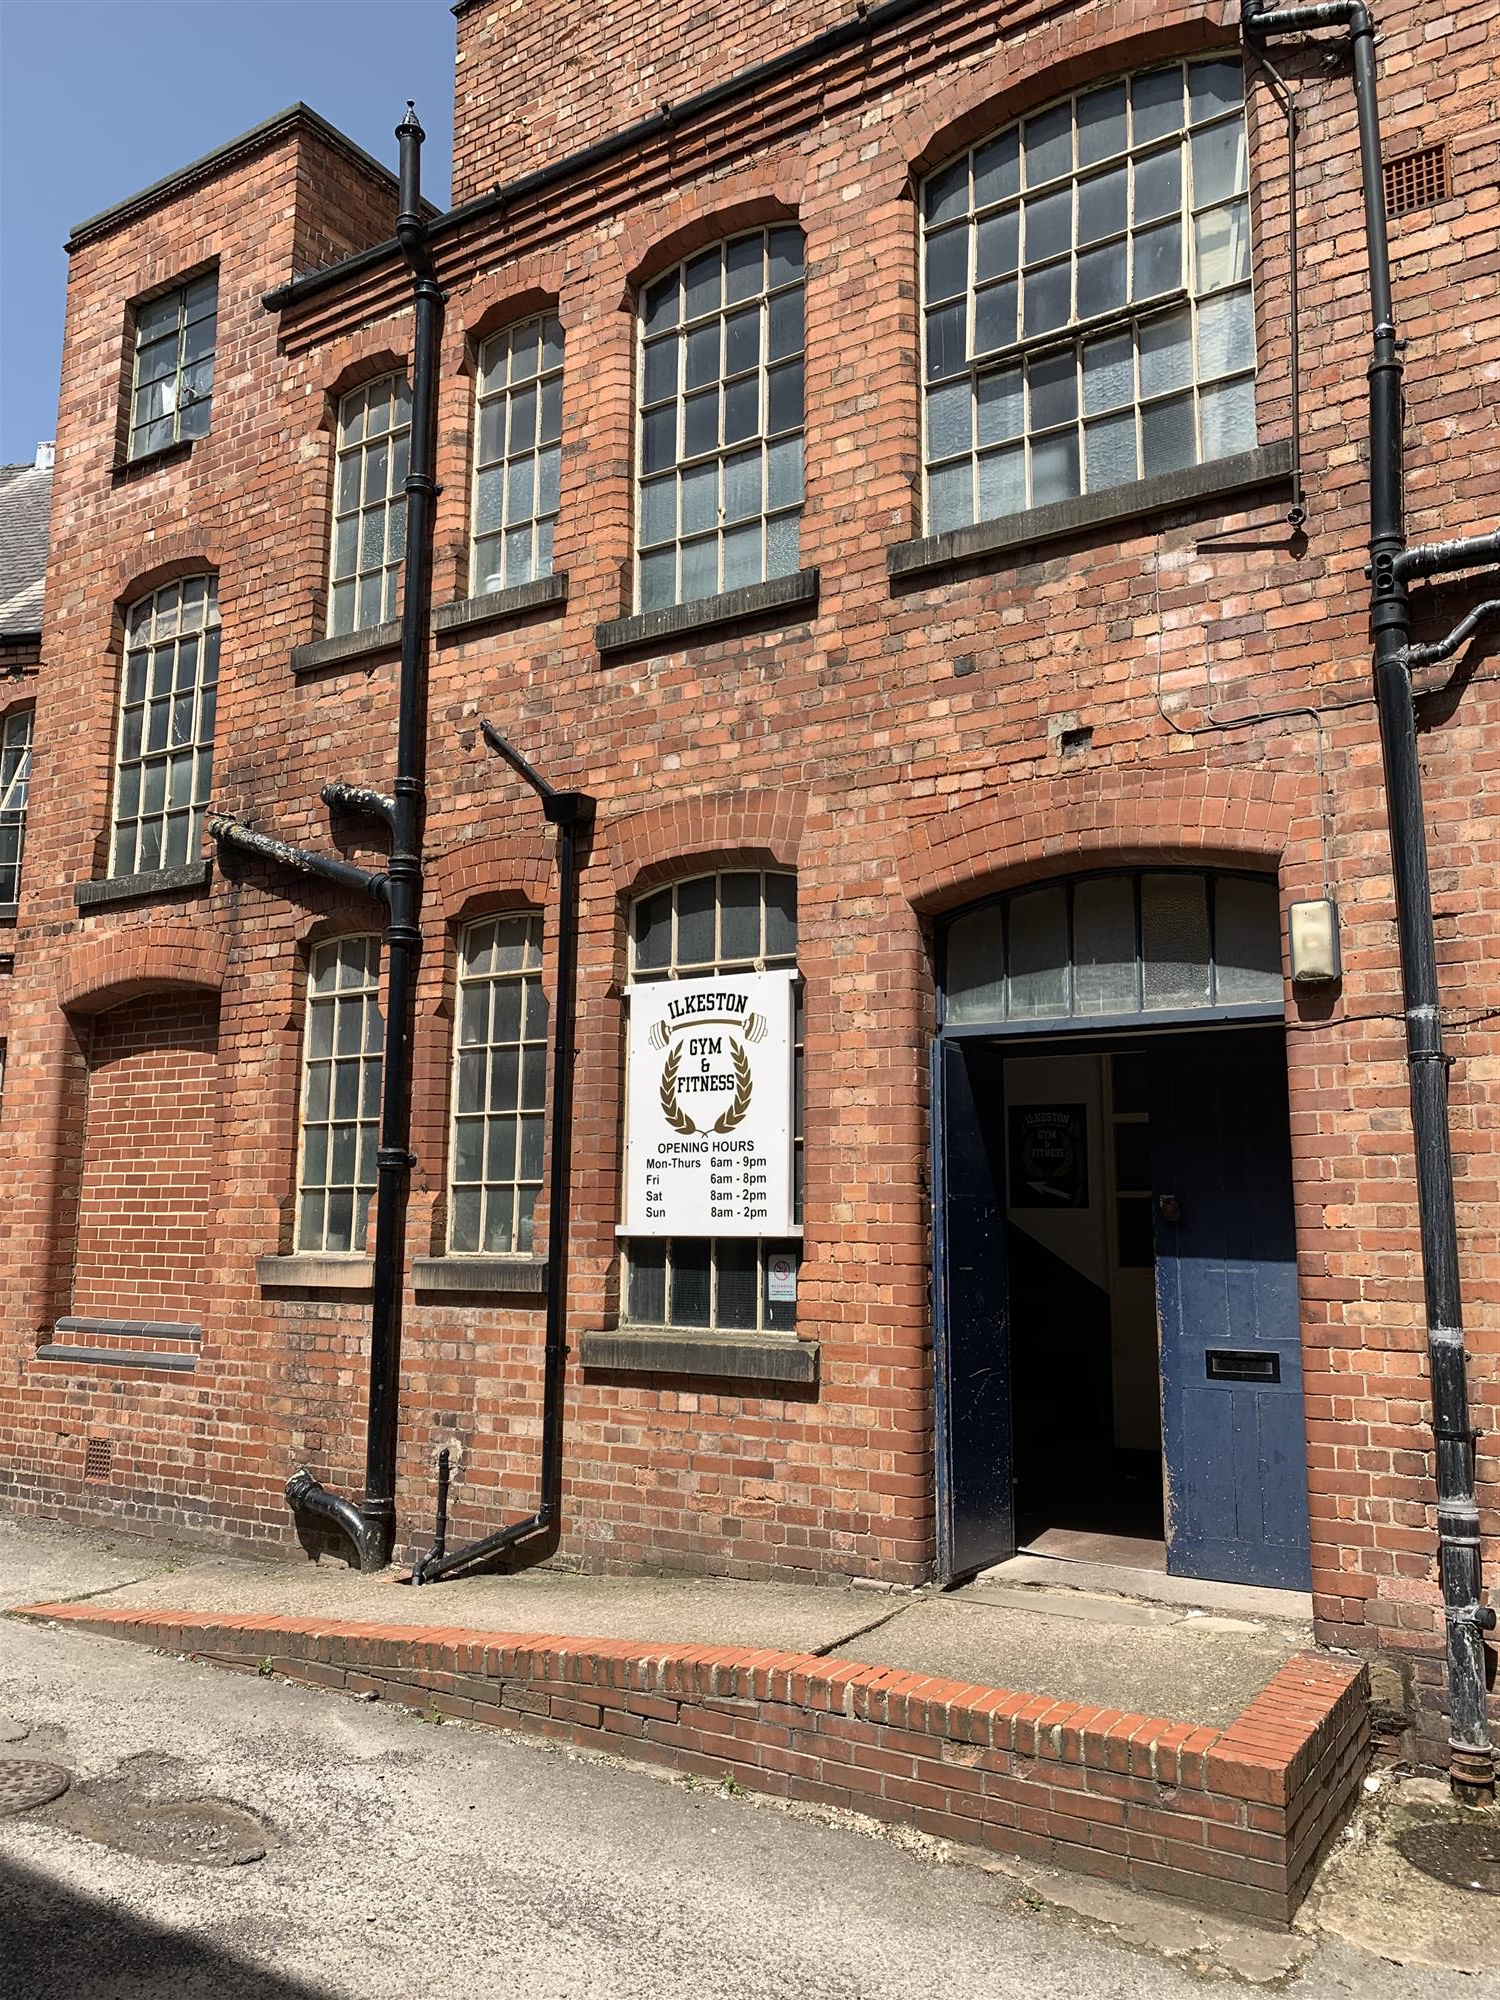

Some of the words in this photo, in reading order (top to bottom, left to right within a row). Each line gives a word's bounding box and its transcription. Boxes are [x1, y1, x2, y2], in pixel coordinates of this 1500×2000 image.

[668, 992, 748, 1019] ILKESTON
[690, 1037, 722, 1055] GYM
[701, 1058, 710, 1072] &
[678, 1074, 734, 1093] FITNESS
[1025, 1113, 1070, 1124] ILKESTON
[1038, 1130, 1056, 1140] GYM
[658, 1142, 709, 1153] OPENING
[713, 1140, 754, 1152] HOURS
[1032, 1148, 1064, 1158] FITNESS
[646, 1158, 701, 1169] Mon-Thurs
[710, 1157, 732, 1167] 6am
[743, 1156, 766, 1169] 9pm
[646, 1175, 659, 1185] Fri
[710, 1173, 732, 1184] 6am
[743, 1173, 766, 1186] 8pm
[646, 1191, 662, 1201] Sat
[710, 1190, 732, 1200] 8am
[743, 1190, 766, 1203] 2pm
[646, 1207, 665, 1218] Sun
[711, 1207, 733, 1217] 8am
[743, 1207, 767, 1220] 2pm
